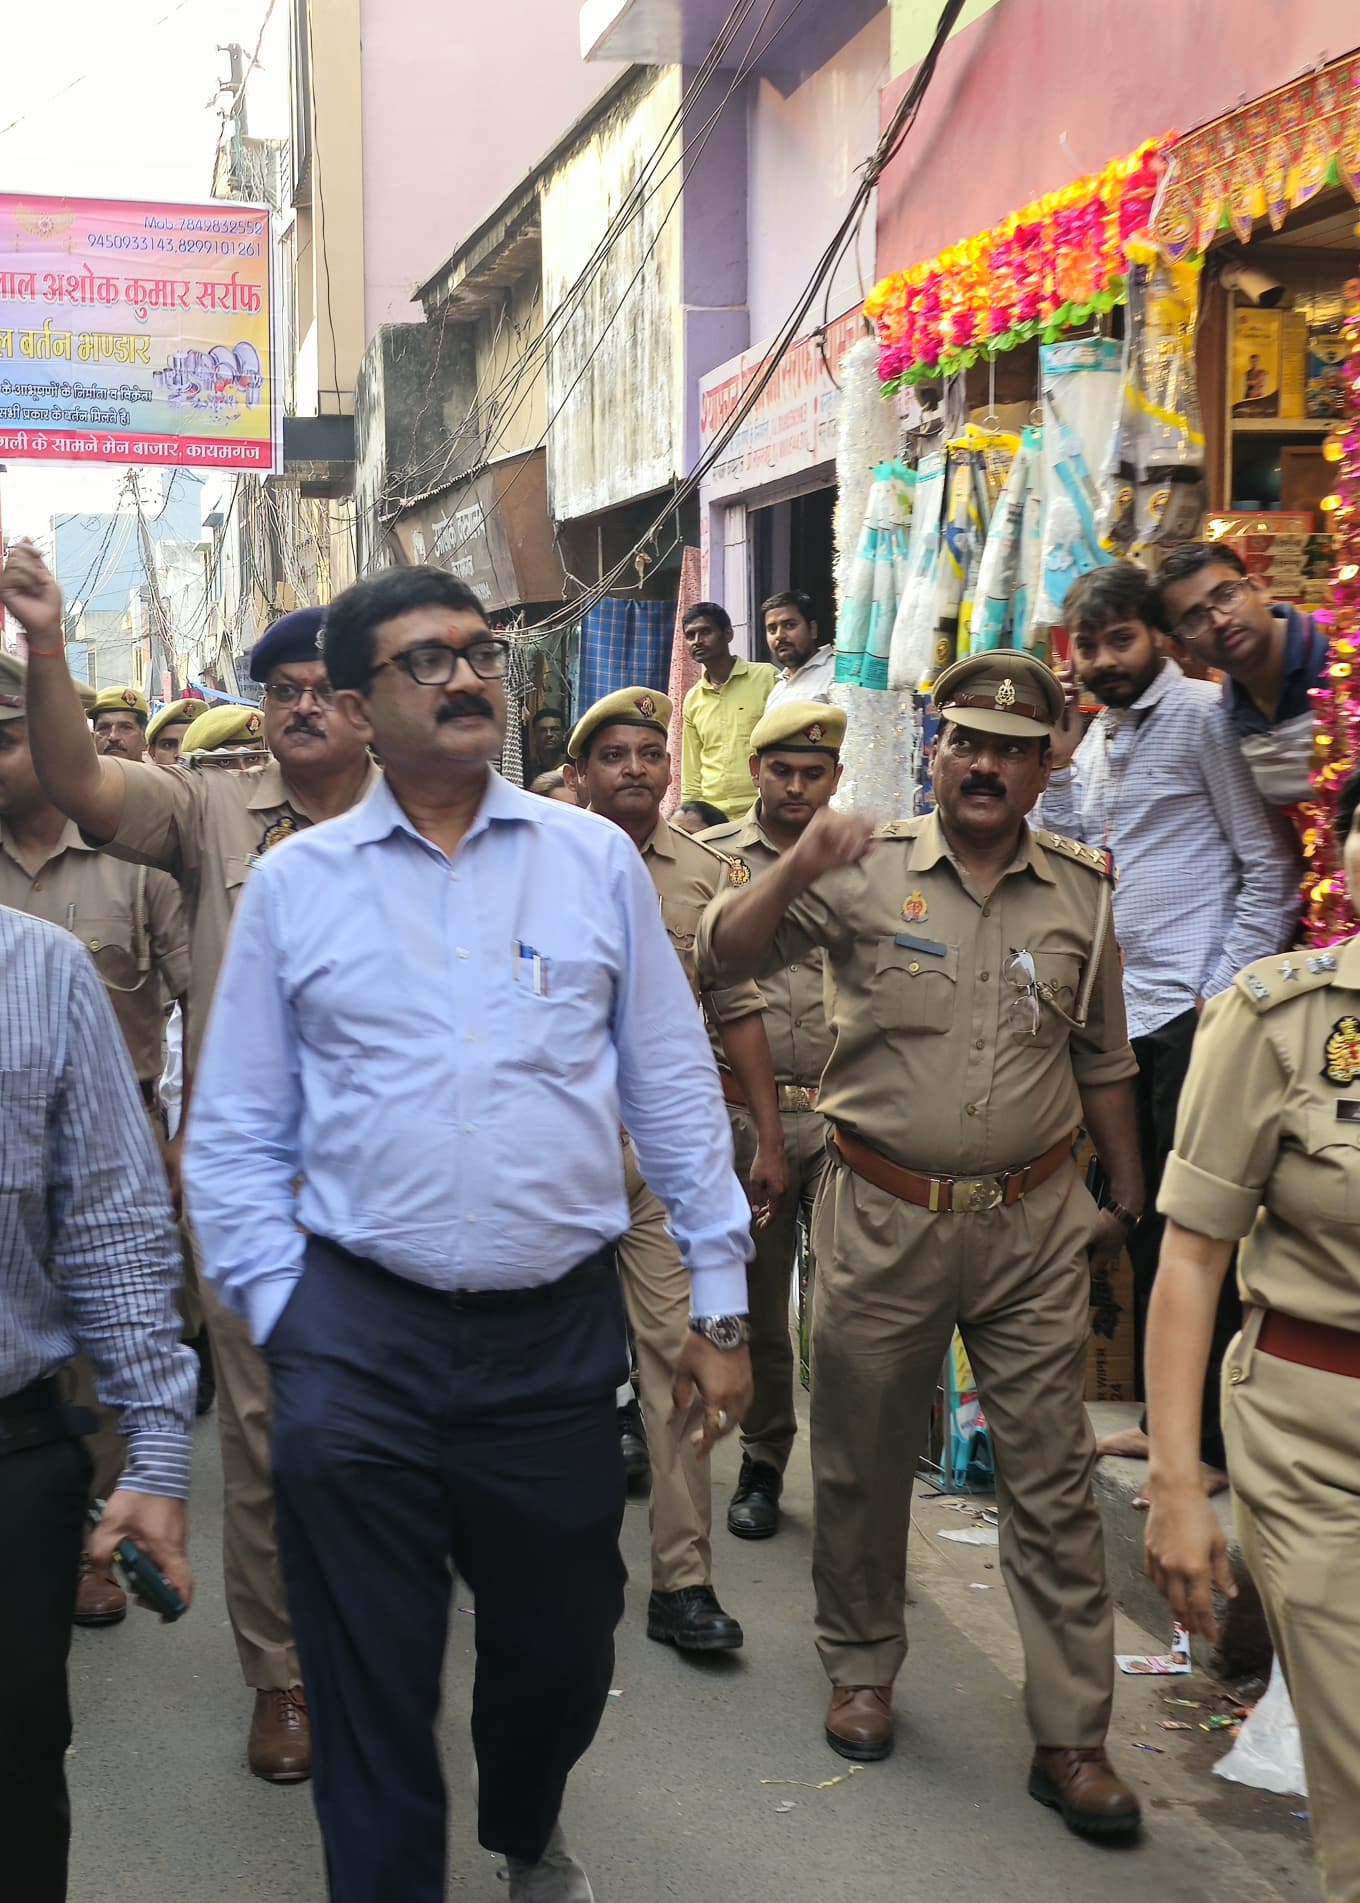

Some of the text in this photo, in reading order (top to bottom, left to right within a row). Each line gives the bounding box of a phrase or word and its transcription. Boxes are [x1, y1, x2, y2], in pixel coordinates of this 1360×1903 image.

[40, 262, 120, 309] अशोक
[122, 276, 192, 324] कुमार
[195, 271, 263, 315] सर्राफ
[17, 316, 74, 361] बर्तन
[77, 331, 153, 366] भण्डार
[0, 378, 13, 396] के
[60, 381, 73, 398] के
[109, 388, 119, 400] व
[22, 407, 50, 422] प्रकार
[50, 404, 64, 422] के
[88, 405, 118, 425] मिलते
[31, 431, 48, 451] के
[51, 435, 100, 454] सामने
[102, 434, 131, 456] मेन
[185, 440, 262, 461] कायमगंज
